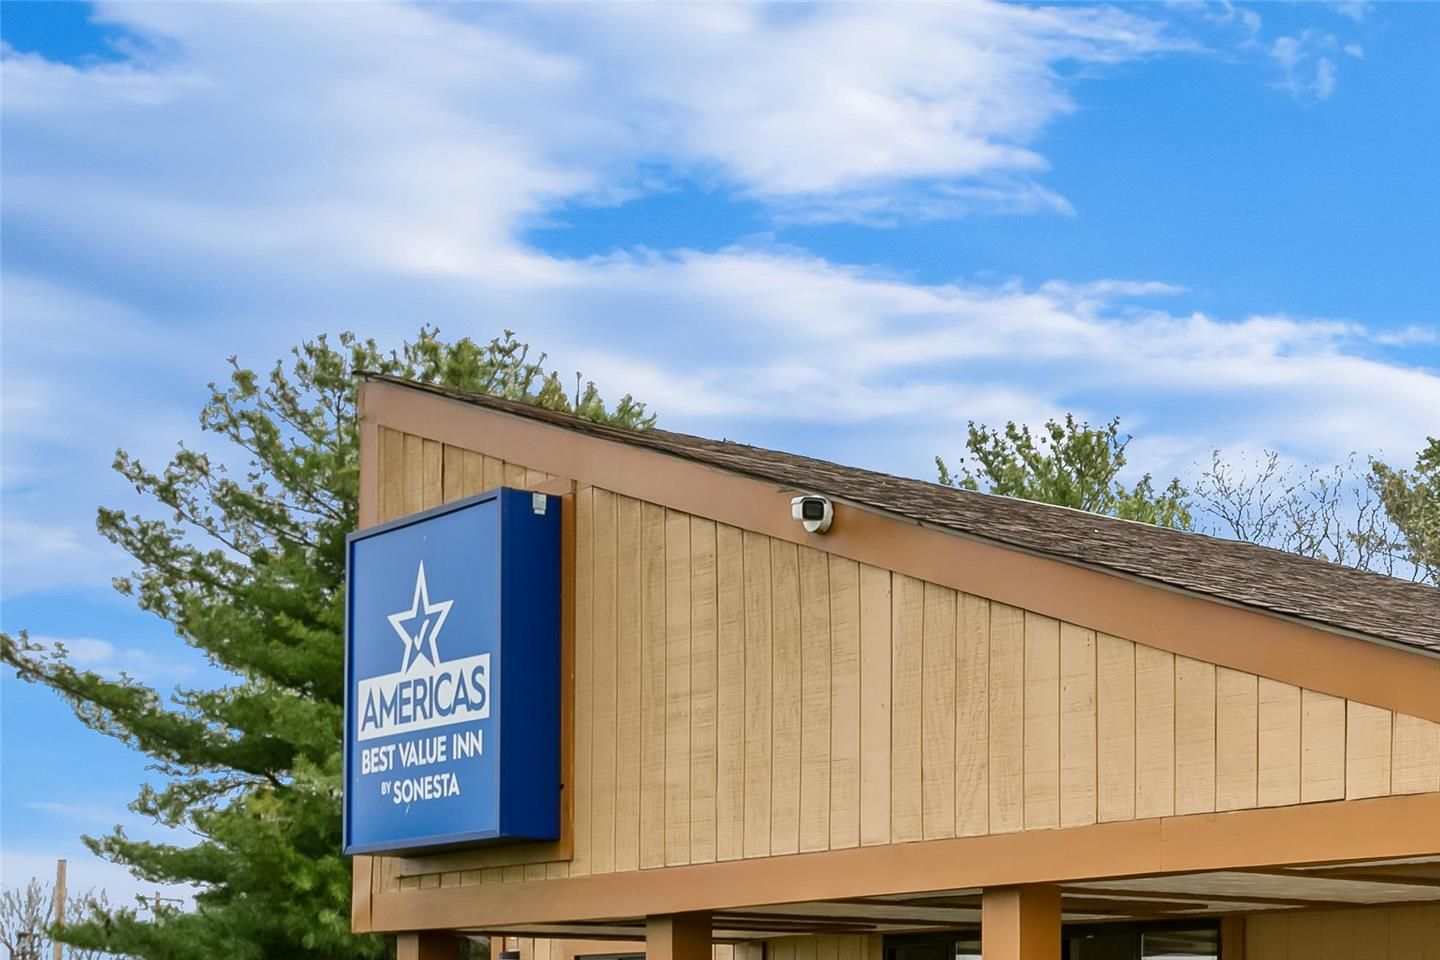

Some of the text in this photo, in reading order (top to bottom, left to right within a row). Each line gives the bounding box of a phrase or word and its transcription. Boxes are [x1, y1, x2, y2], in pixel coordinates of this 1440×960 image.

[361, 665, 486, 732] AMERICAS
[362, 729, 483, 775] BEST VALUE INN
[381, 772, 460, 804] BY SONESTA
